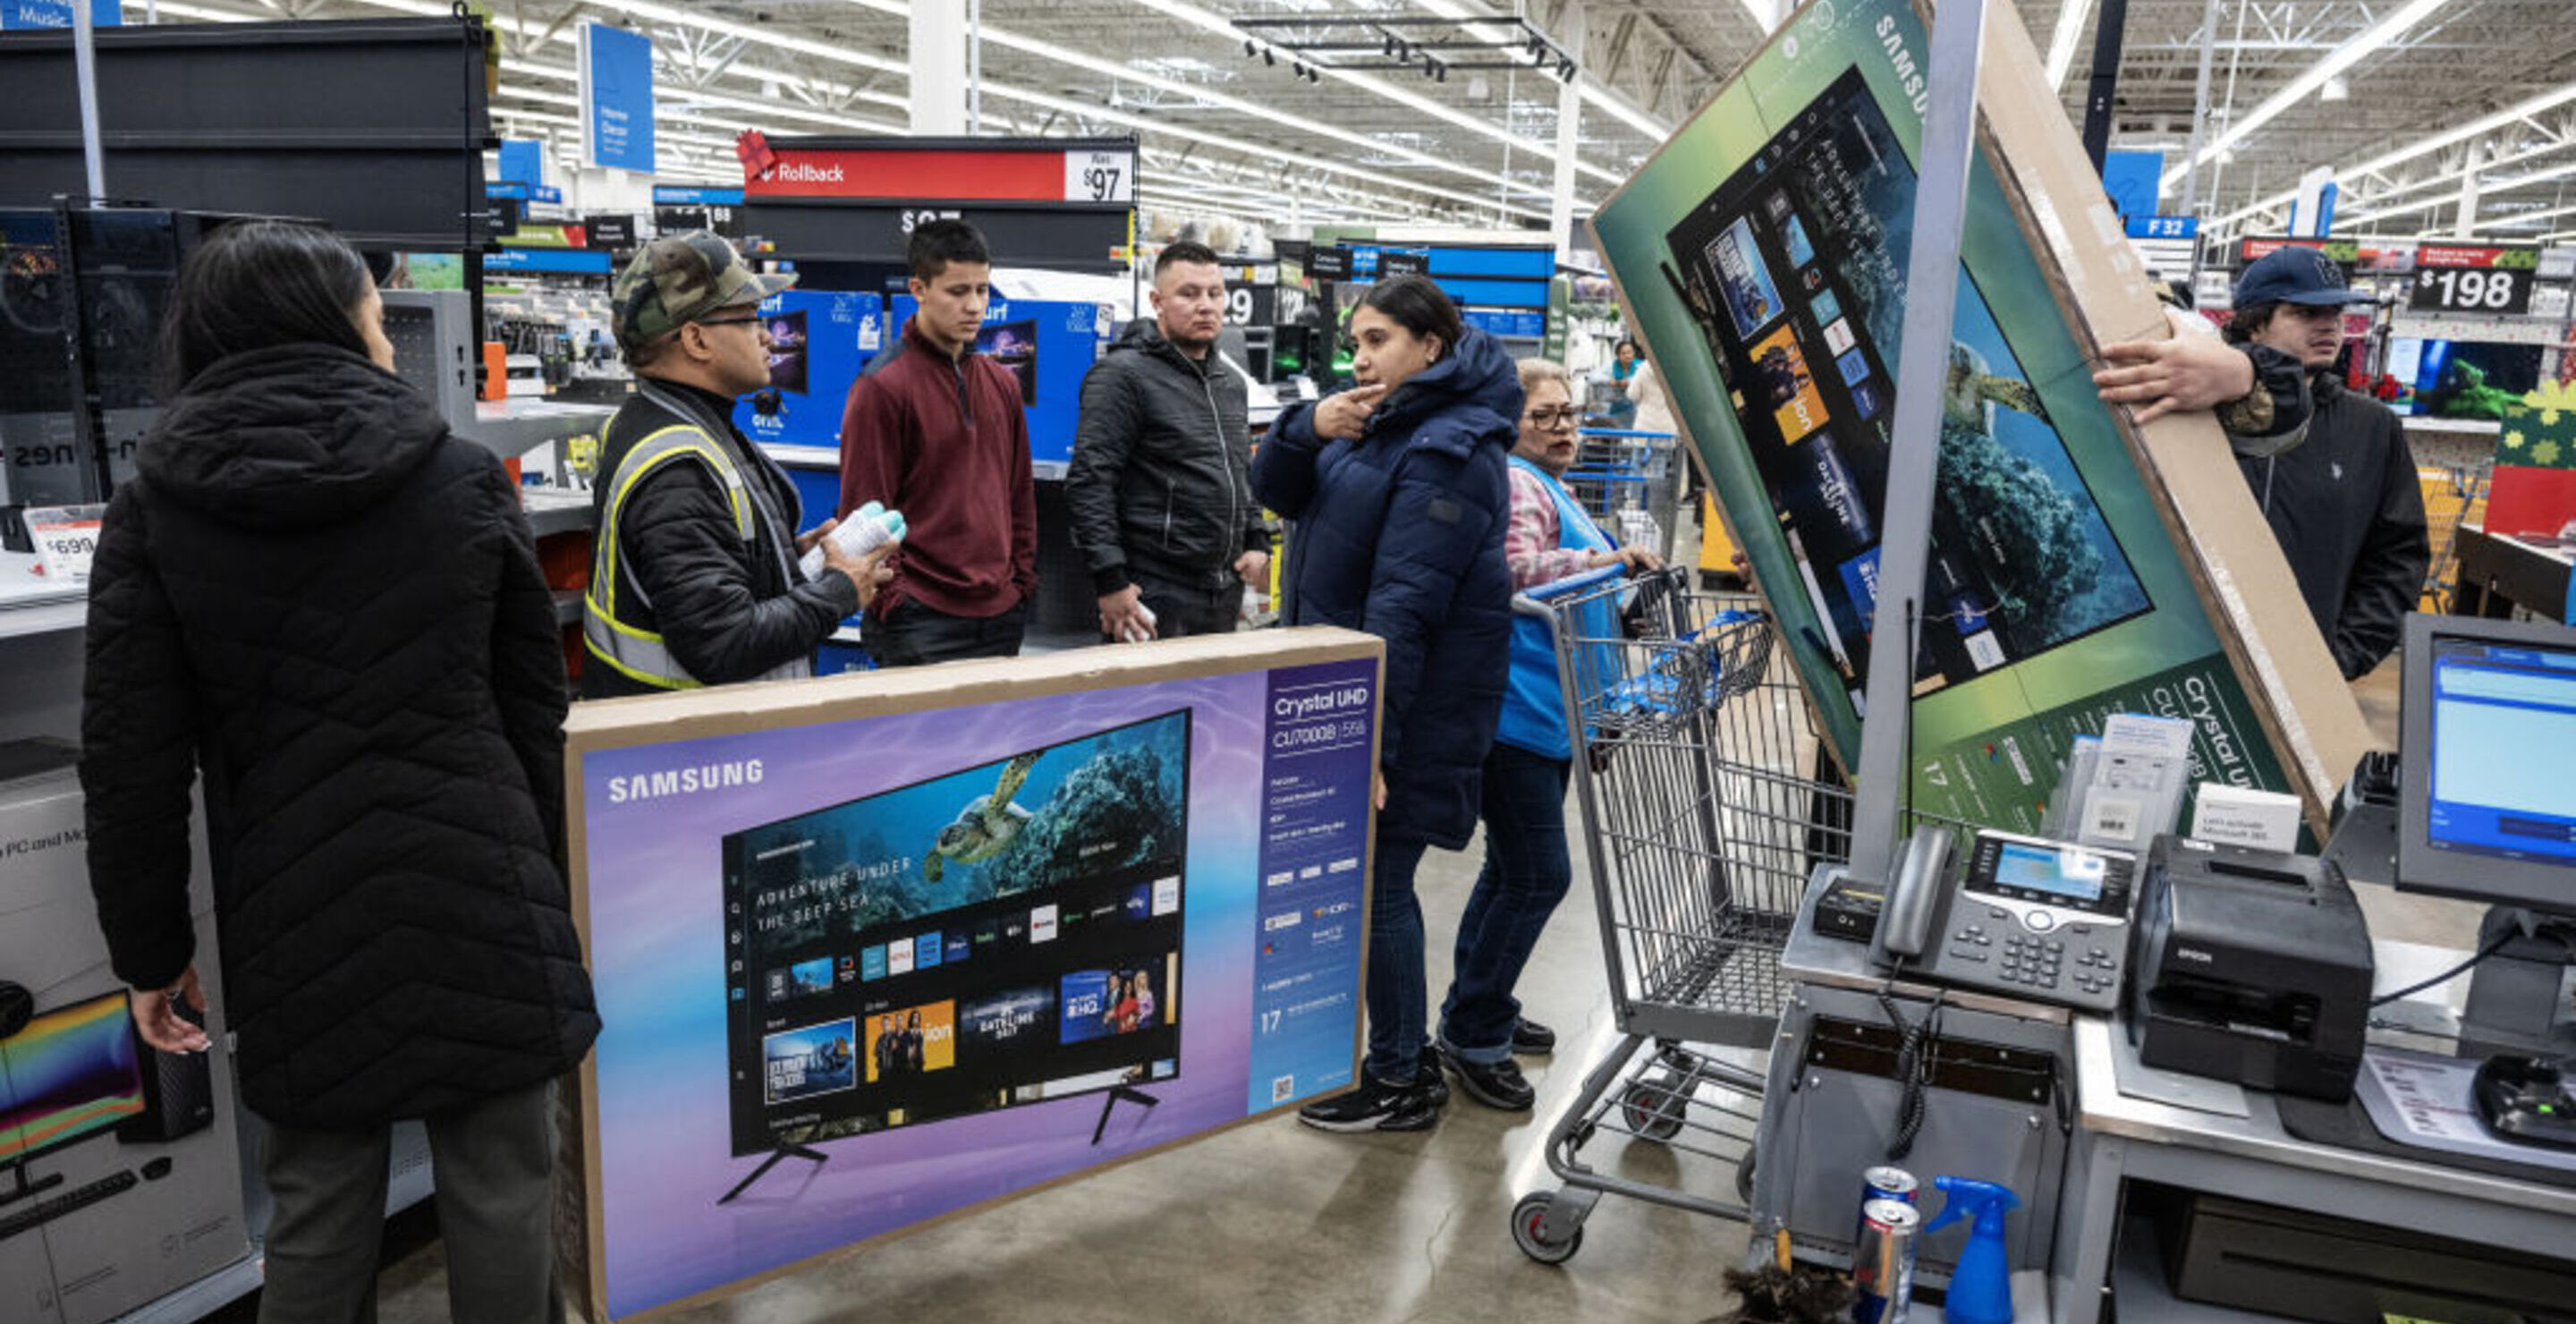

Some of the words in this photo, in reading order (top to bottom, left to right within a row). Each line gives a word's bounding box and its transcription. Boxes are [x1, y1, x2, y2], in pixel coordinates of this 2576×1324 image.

[20, 6, 66, 27] Music
[1876, 14, 1928, 124] SAMSU
[778, 162, 844, 182] Rollback
[1083, 167, 1120, 200] $97
[2148, 219, 2161, 235] F
[2162, 219, 2182, 235] 32
[2419, 269, 2514, 309] $198
[1274, 692, 1335, 718] Crystal
[1337, 687, 1368, 708] UHD
[2185, 676, 2241, 766] Crystal
[606, 760, 763, 802] SAMSUNG
[1923, 760, 1948, 785] 17
[7, 841, 29, 857] PC
[32, 832, 62, 851] and
[856, 855, 911, 881] UNDER
[838, 892, 870, 912] SEA
[926, 1022, 953, 1044] ion
[1261, 1010, 1282, 1034] 17
